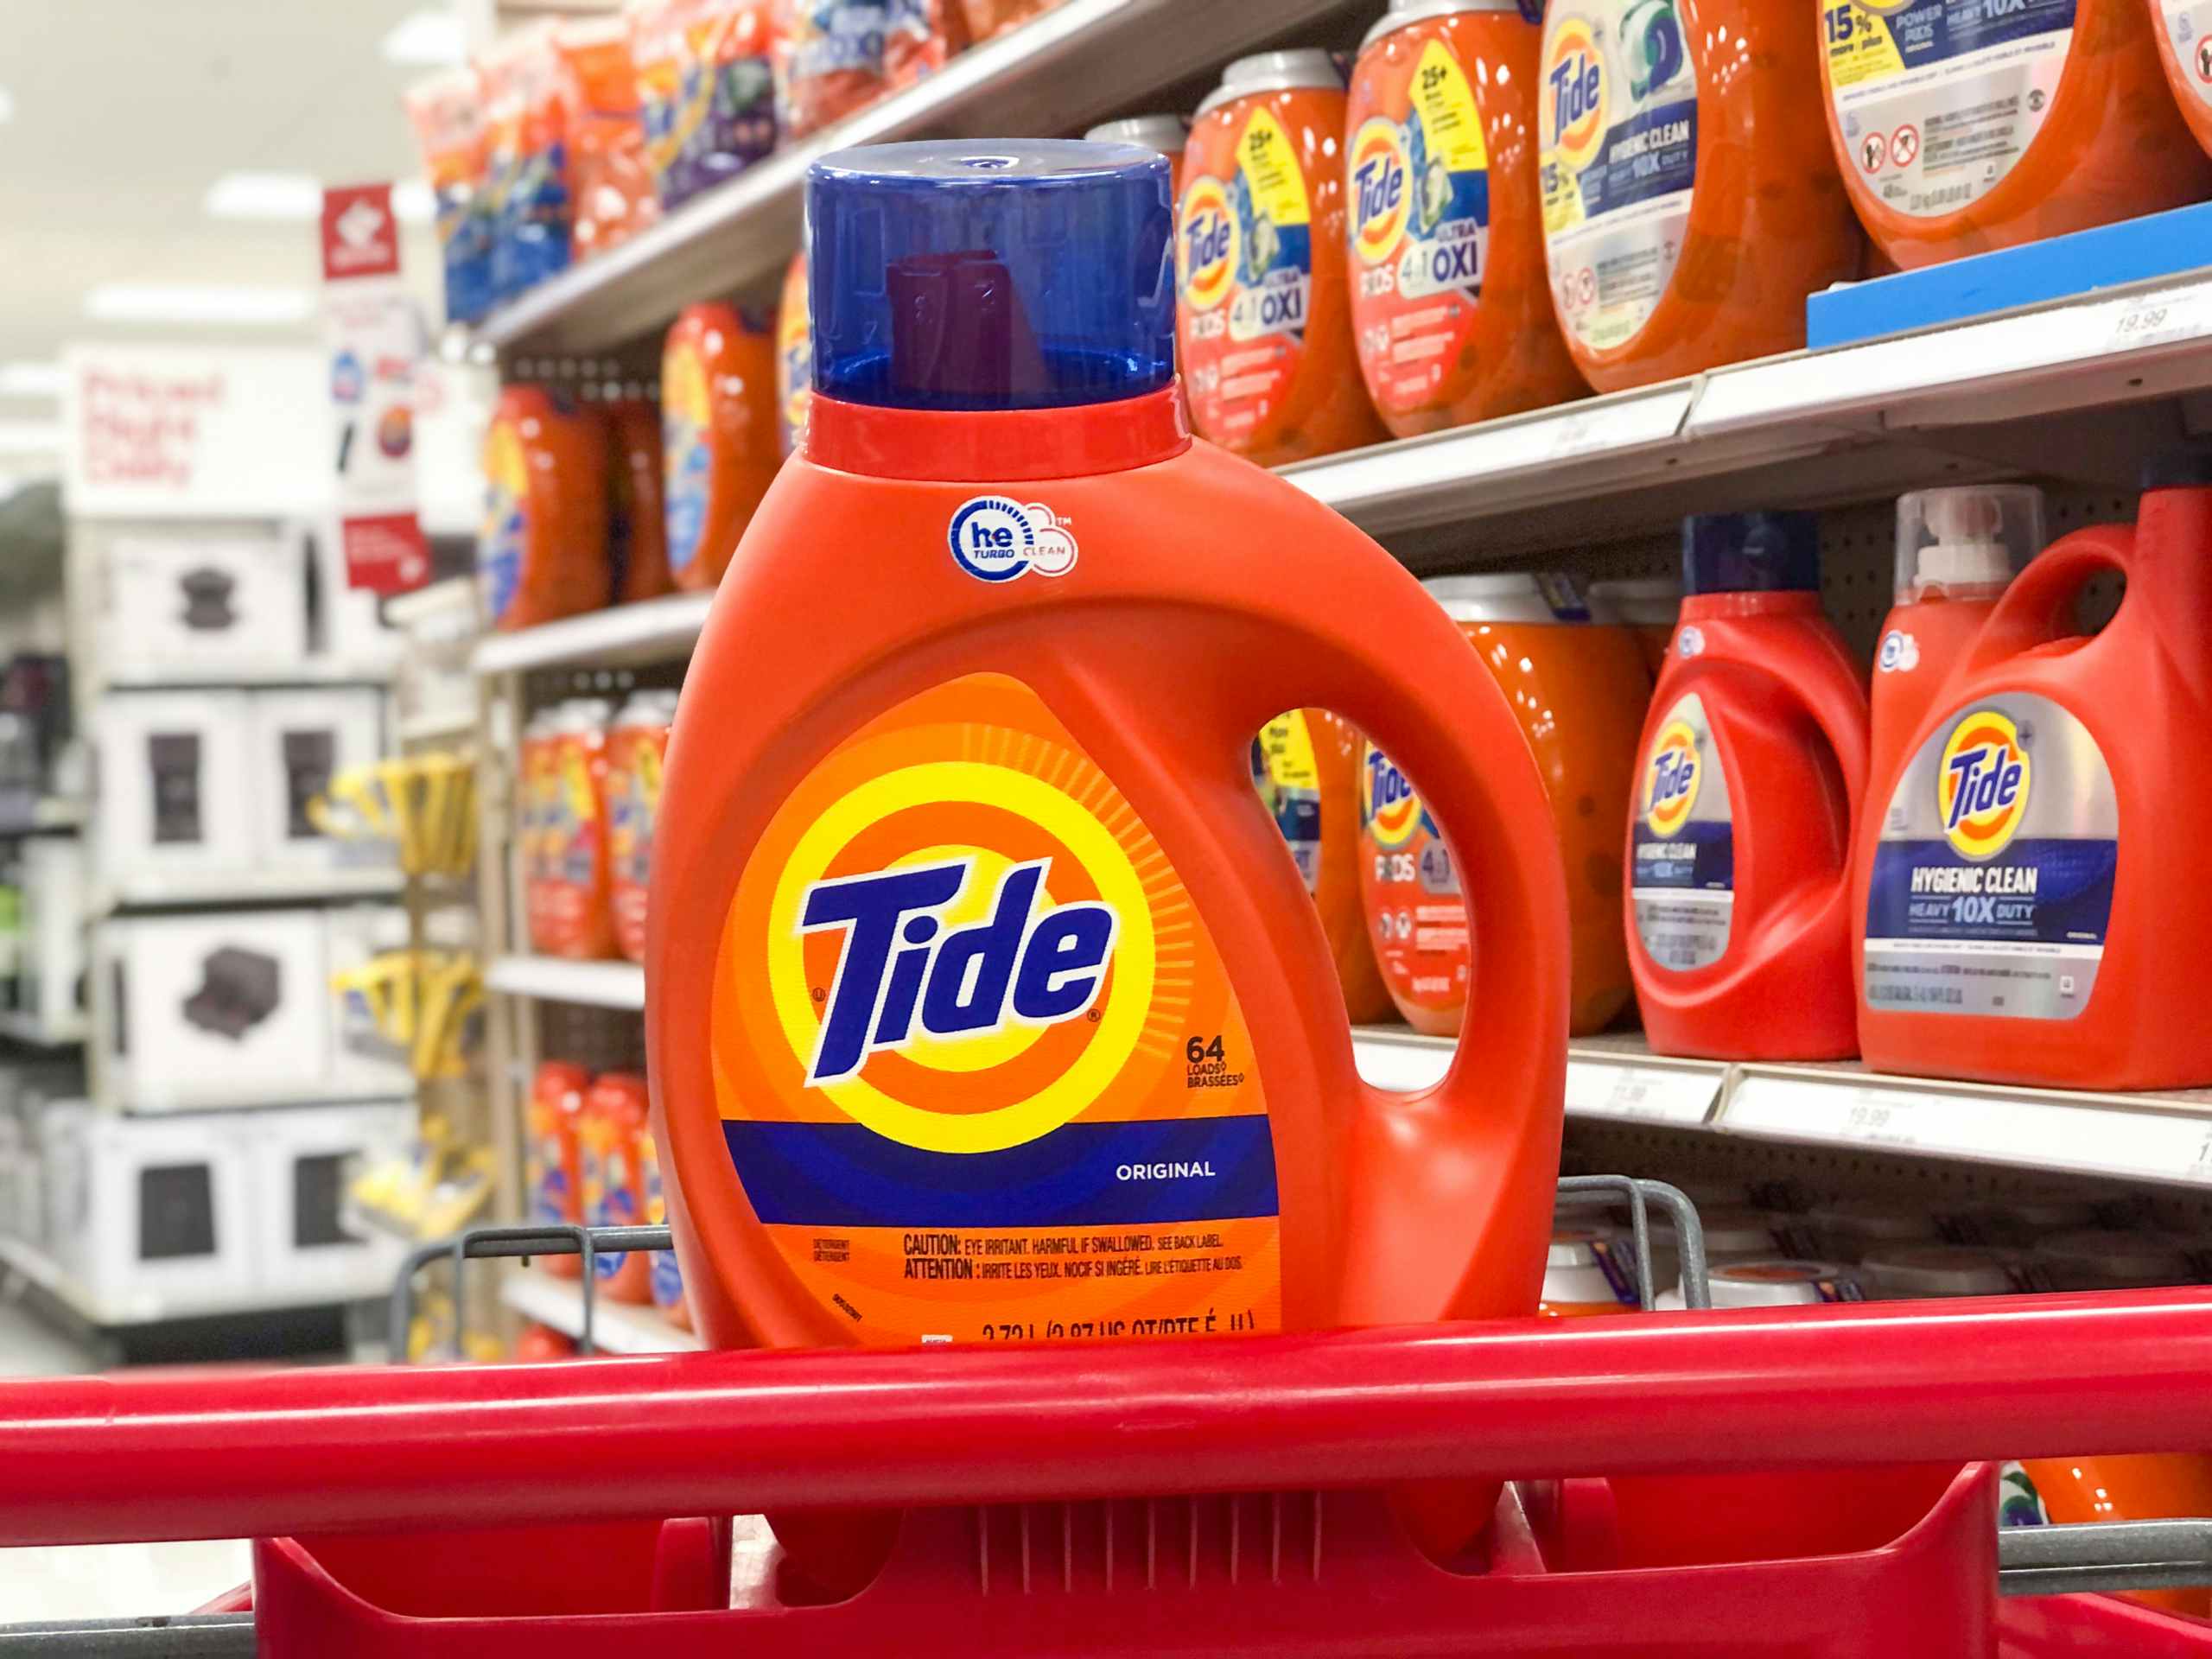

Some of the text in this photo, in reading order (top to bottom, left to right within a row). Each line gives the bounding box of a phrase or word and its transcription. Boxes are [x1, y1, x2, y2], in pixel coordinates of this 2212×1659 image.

[1896, 4, 1942, 29] POWER
[1549, 53, 1599, 145] Tide
[1649, 120, 1689, 149] CLEAN
[1354, 156, 1403, 232] Tide
[1185, 212, 1231, 279] Tide
[1433, 239, 1478, 283] OXI
[1261, 288, 1301, 326] OXI
[971, 521, 1013, 548] he
[974, 549, 1015, 559] TURBO
[1022, 546, 1065, 556] CLEAN
[1649, 750, 1694, 812] Tide
[1948, 747, 2022, 829] Tide
[1910, 867, 2038, 894] HYGIENIC CLEAN
[1909, 895, 2034, 924] HEAVY 10X DUTY
[798, 860, 1116, 1084] Tide
[1186, 1035, 1225, 1064] 64
[1116, 1161, 1217, 1181] ORIGINAL
[904, 1233, 962, 1255] CAUTION:
[965, 1238, 982, 1255] EYE
[1033, 1237, 1079, 1255] HARMFUL
[1081, 1236, 1090, 1253] IF
[1091, 1234, 1155, 1253] SWALLOWED.
[1158, 1236, 1173, 1250] SEE
[1174, 1235, 1196, 1249] BACK
[904, 1257, 973, 1279] ATTENTION
[982, 1262, 1012, 1279] IRRITE
[1014, 1262, 1033, 1279] LES
[1064, 1261, 1093, 1277] NOCIF
[1094, 1260, 1104, 1277] SI
[1145, 1260, 1162, 1274] LIRE
[1213, 1256, 1225, 1271] AU
